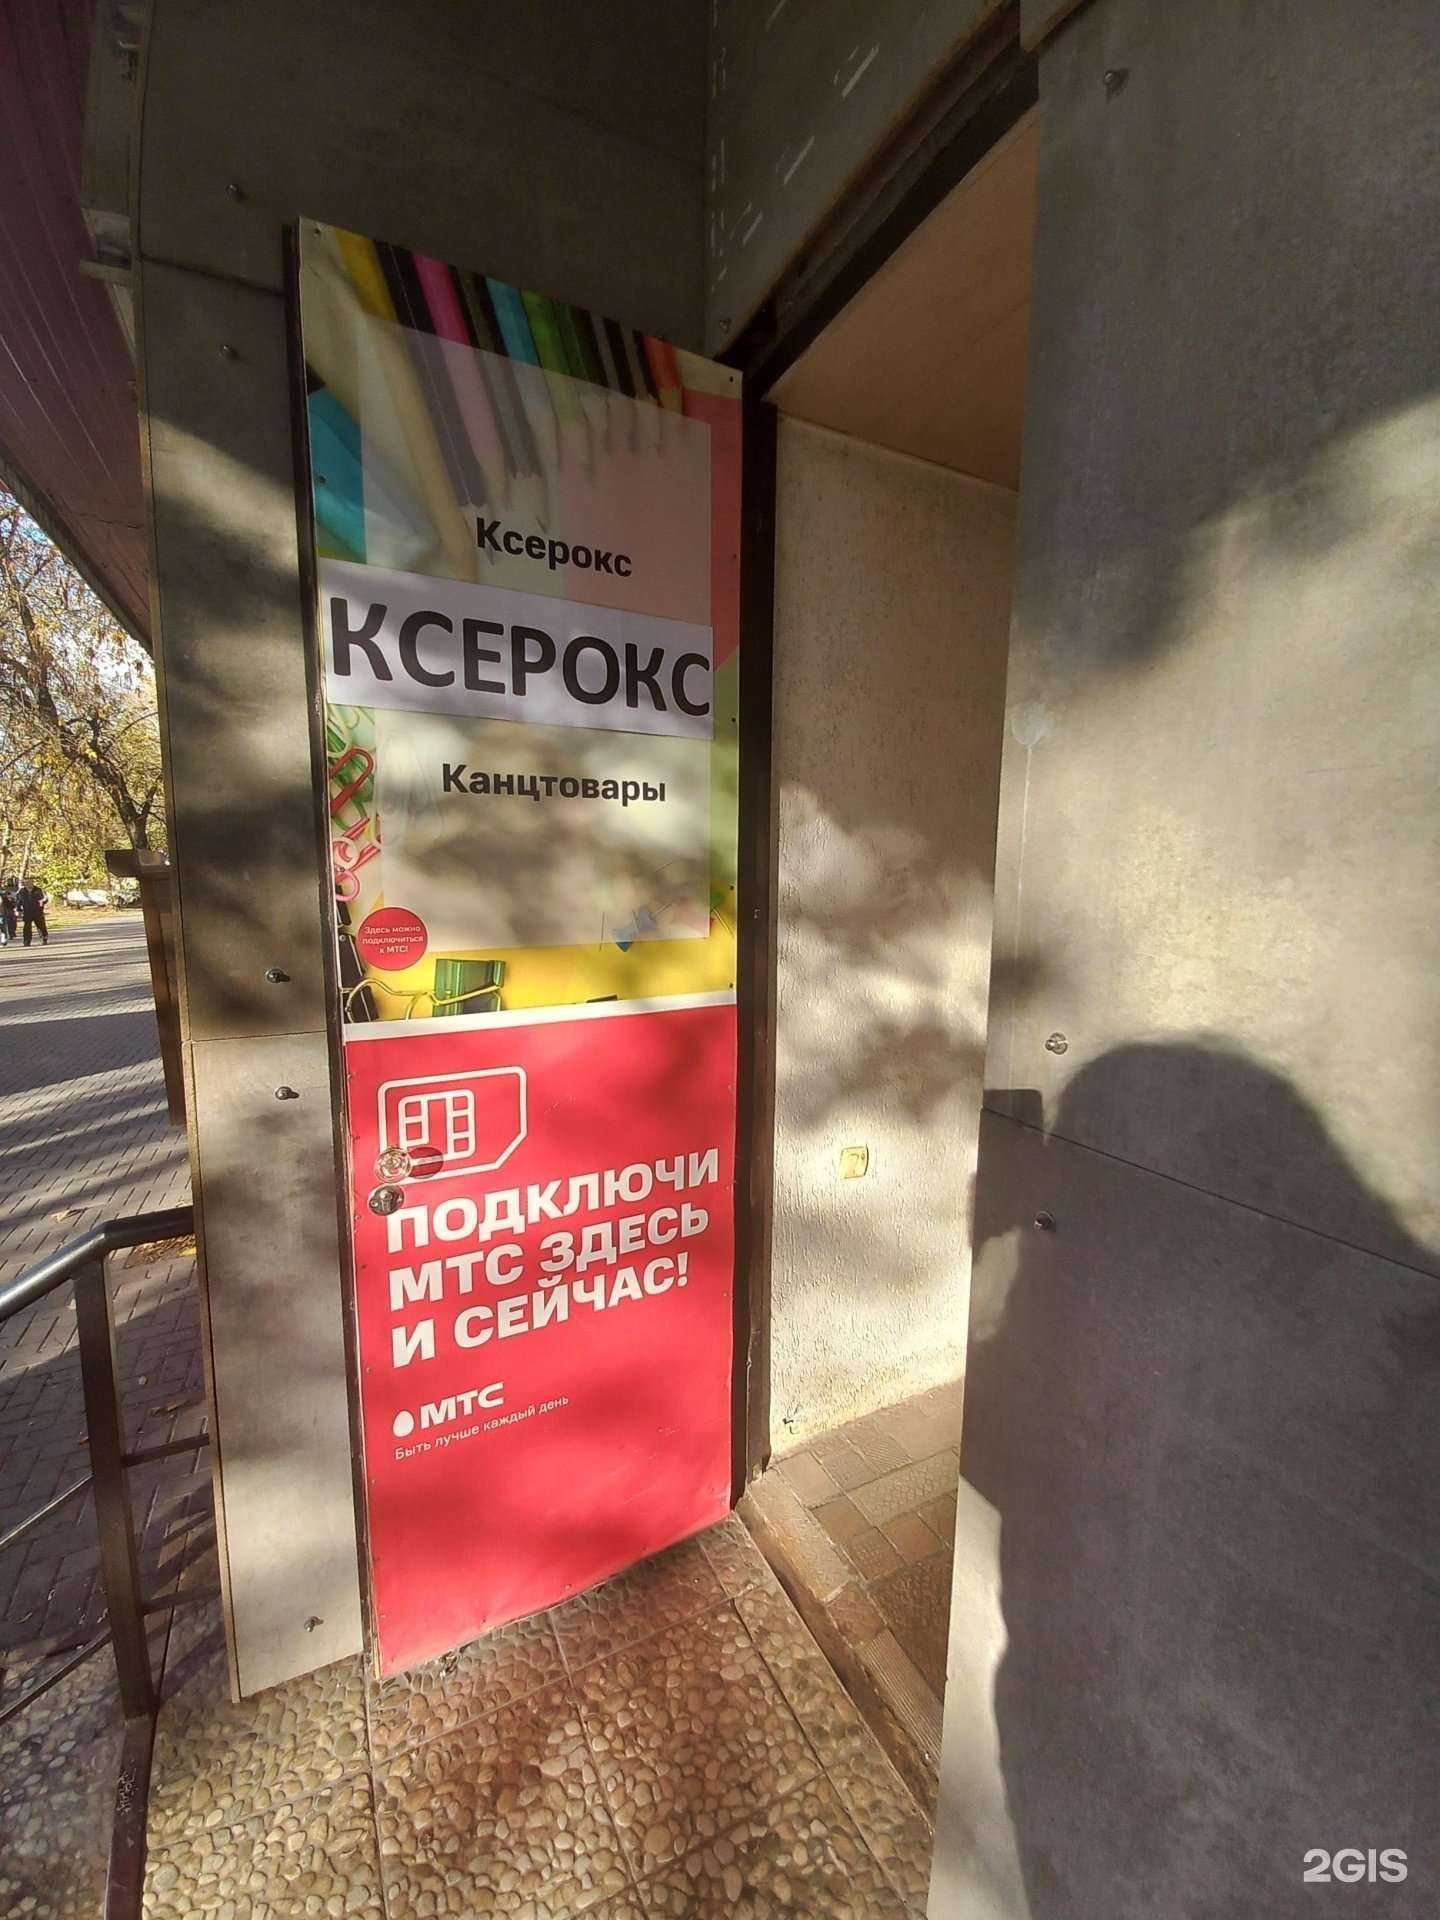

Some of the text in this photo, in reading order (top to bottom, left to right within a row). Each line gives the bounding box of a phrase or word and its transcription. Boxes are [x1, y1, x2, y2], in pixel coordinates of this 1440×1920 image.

[476, 517, 633, 578] Ксерокс
[330, 596, 711, 717] КСЕРОКС
[441, 763, 667, 806] Канцтовары
[363, 936, 424, 944] подключиться
[364, 926, 390, 934] Здесь
[386, 1148, 719, 1254] ПОДКЛЮЧИ
[388, 1202, 709, 1312] МТС ЗДЕСЬ
[391, 1252, 689, 1369] И СЕЙЧАС!
[394, 1396, 570, 1461] Быть лучше каждый день
[420, 1381, 504, 1430] МТС
